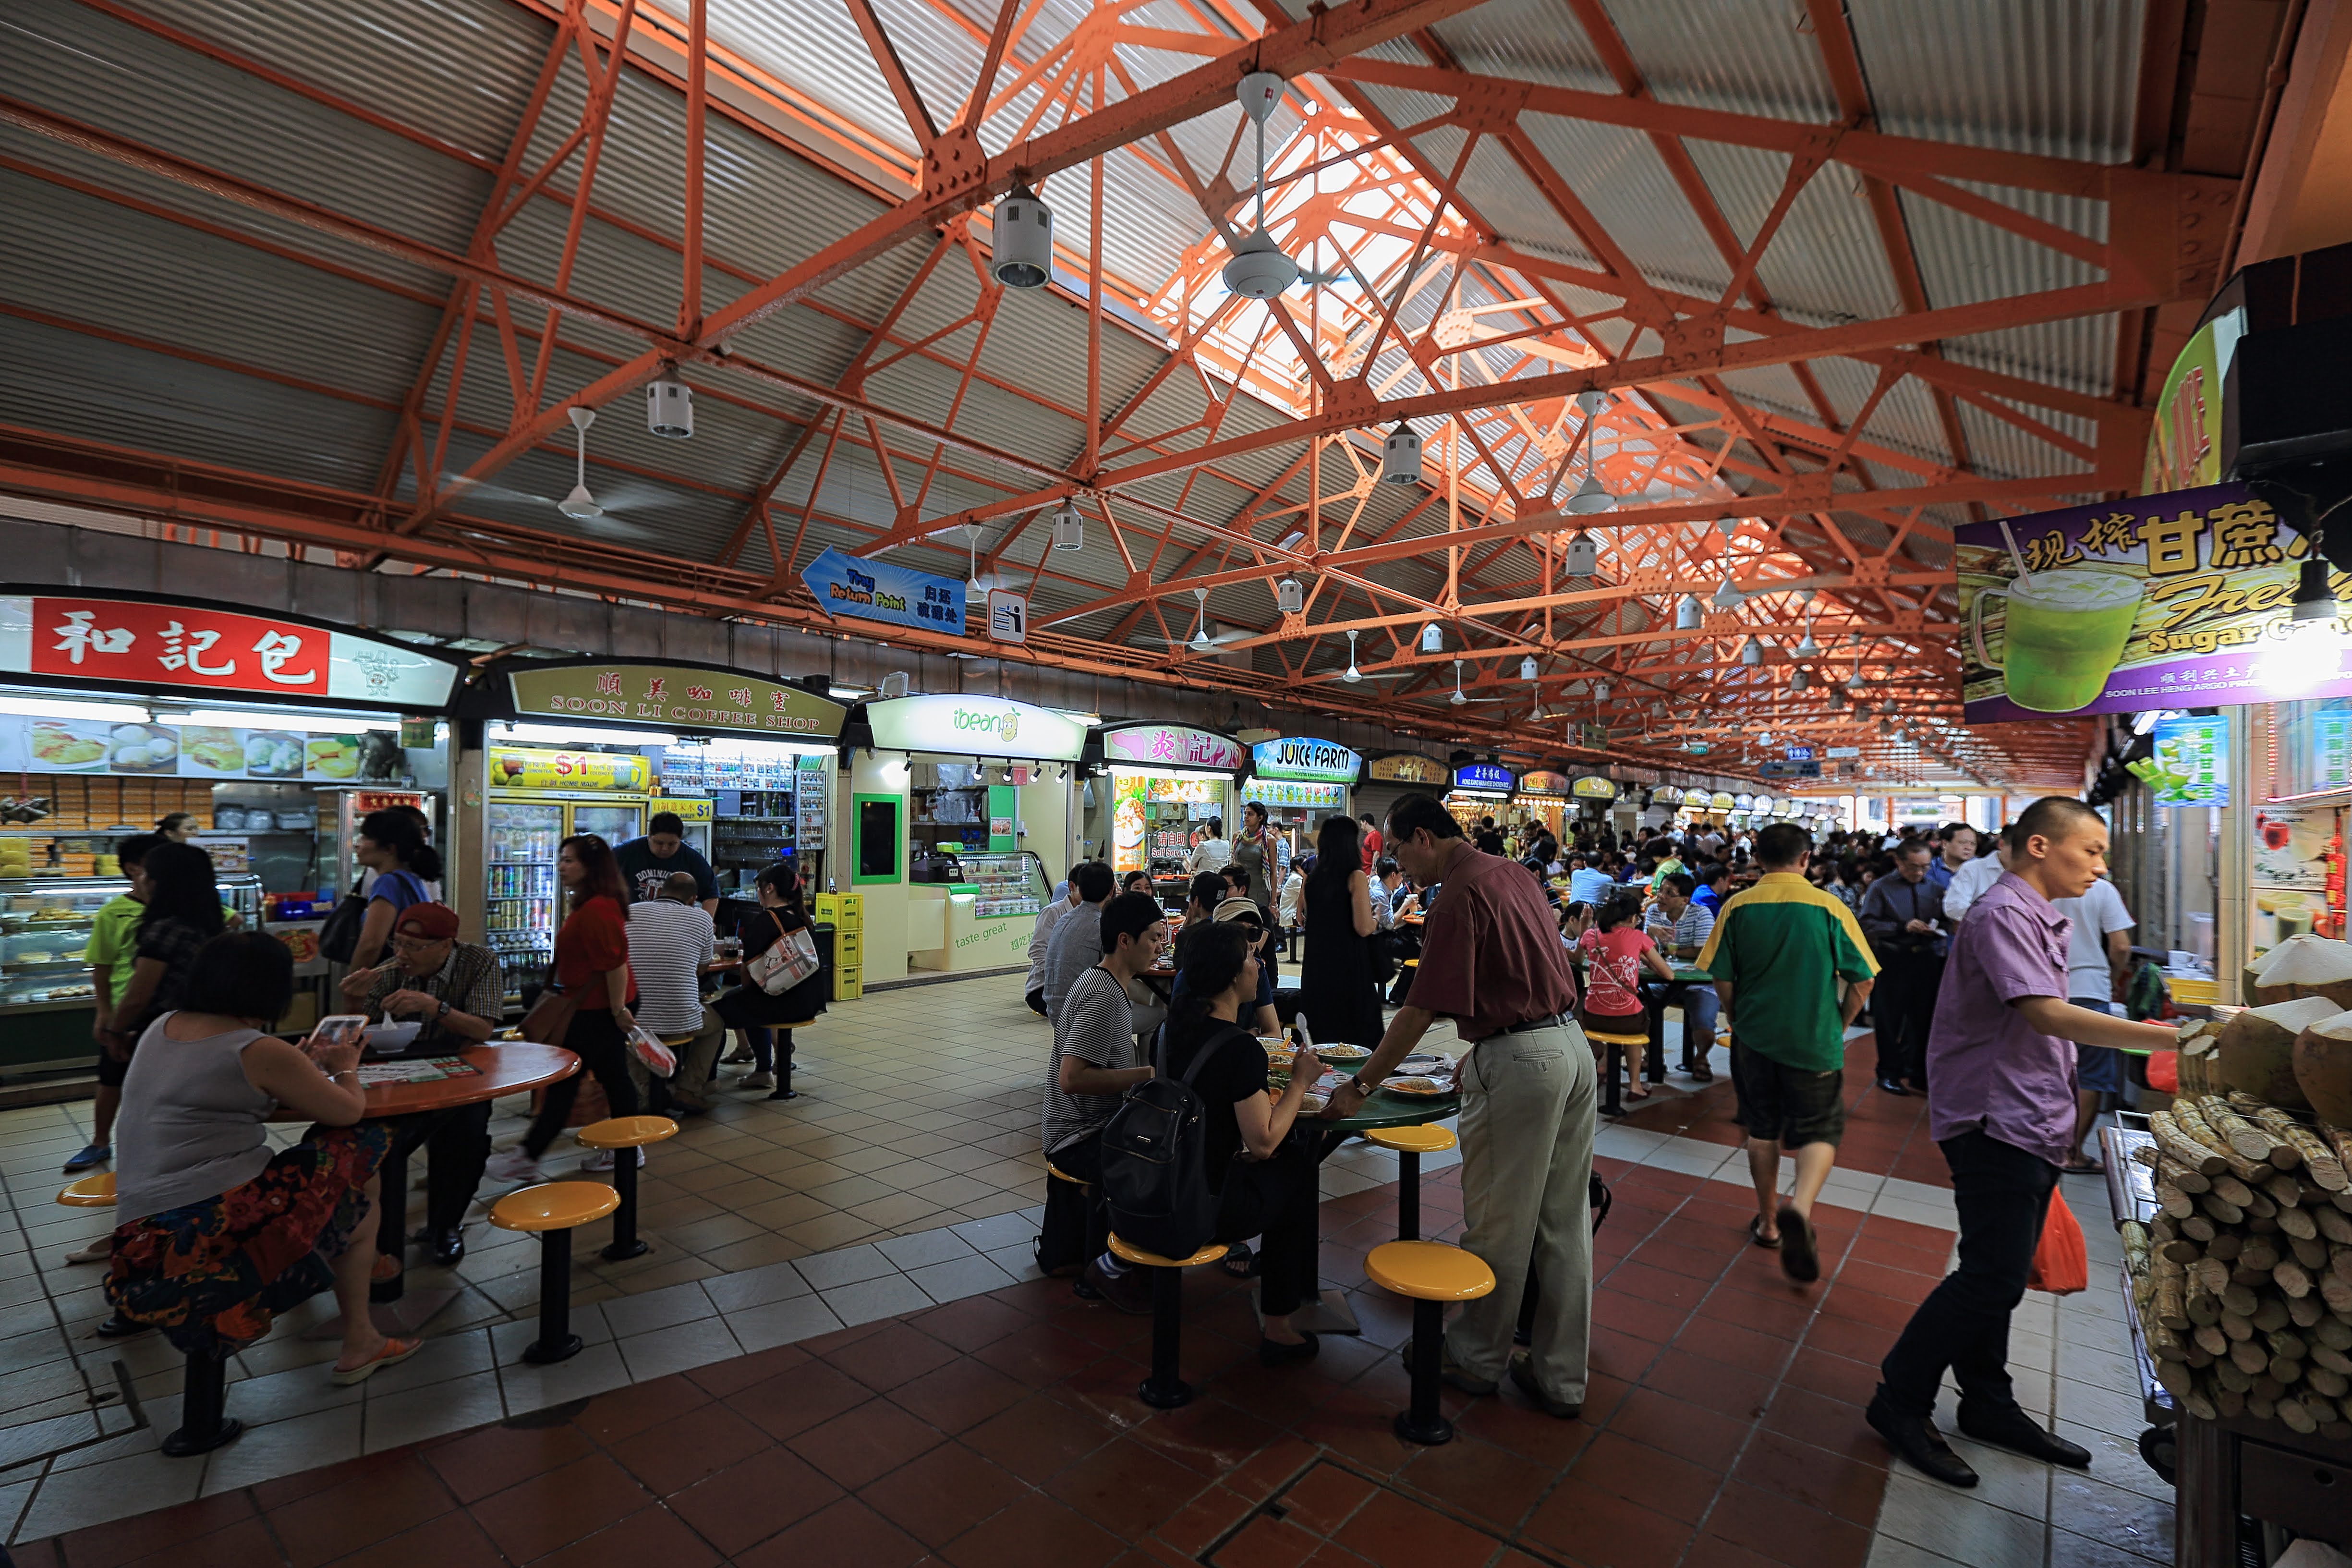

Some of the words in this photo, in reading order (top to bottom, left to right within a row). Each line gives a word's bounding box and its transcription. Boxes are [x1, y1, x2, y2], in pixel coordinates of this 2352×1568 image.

[2026, 512, 2139, 571] 现榨
[846, 568, 875, 592] Tray
[830, 582, 872, 604] Return
[875, 591, 906, 612] Point
[924, 585, 951, 605] 归还
[917, 601, 957, 623] 碗碟处
[52, 610, 317, 685] 和記包
[2148, 624, 2262, 653] Sugar
[2105, 689, 2136, 698] SOON
[2137, 687, 2160, 695] LEE
[2160, 683, 2192, 693] HENG
[2193, 681, 2228, 690] ARGO
[551, 695, 627, 715] SOON
[636, 703, 661, 717] LI
[671, 706, 757, 725] COFFEE
[765, 715, 820, 730] SHOP
[953, 707, 1001, 733] ibean
[1150, 730, 1212, 763] 炎記
[1276, 740, 1312, 767] JUICE
[1314, 745, 1349, 770] FARM
[555, 754, 586, 777] $1
[697, 804, 709, 817] $1
[1152, 847, 1165, 858] Self
[1158, 832, 1186, 847] 请自助
[955, 933, 979, 948] taste
[982, 922, 1007, 941] great
